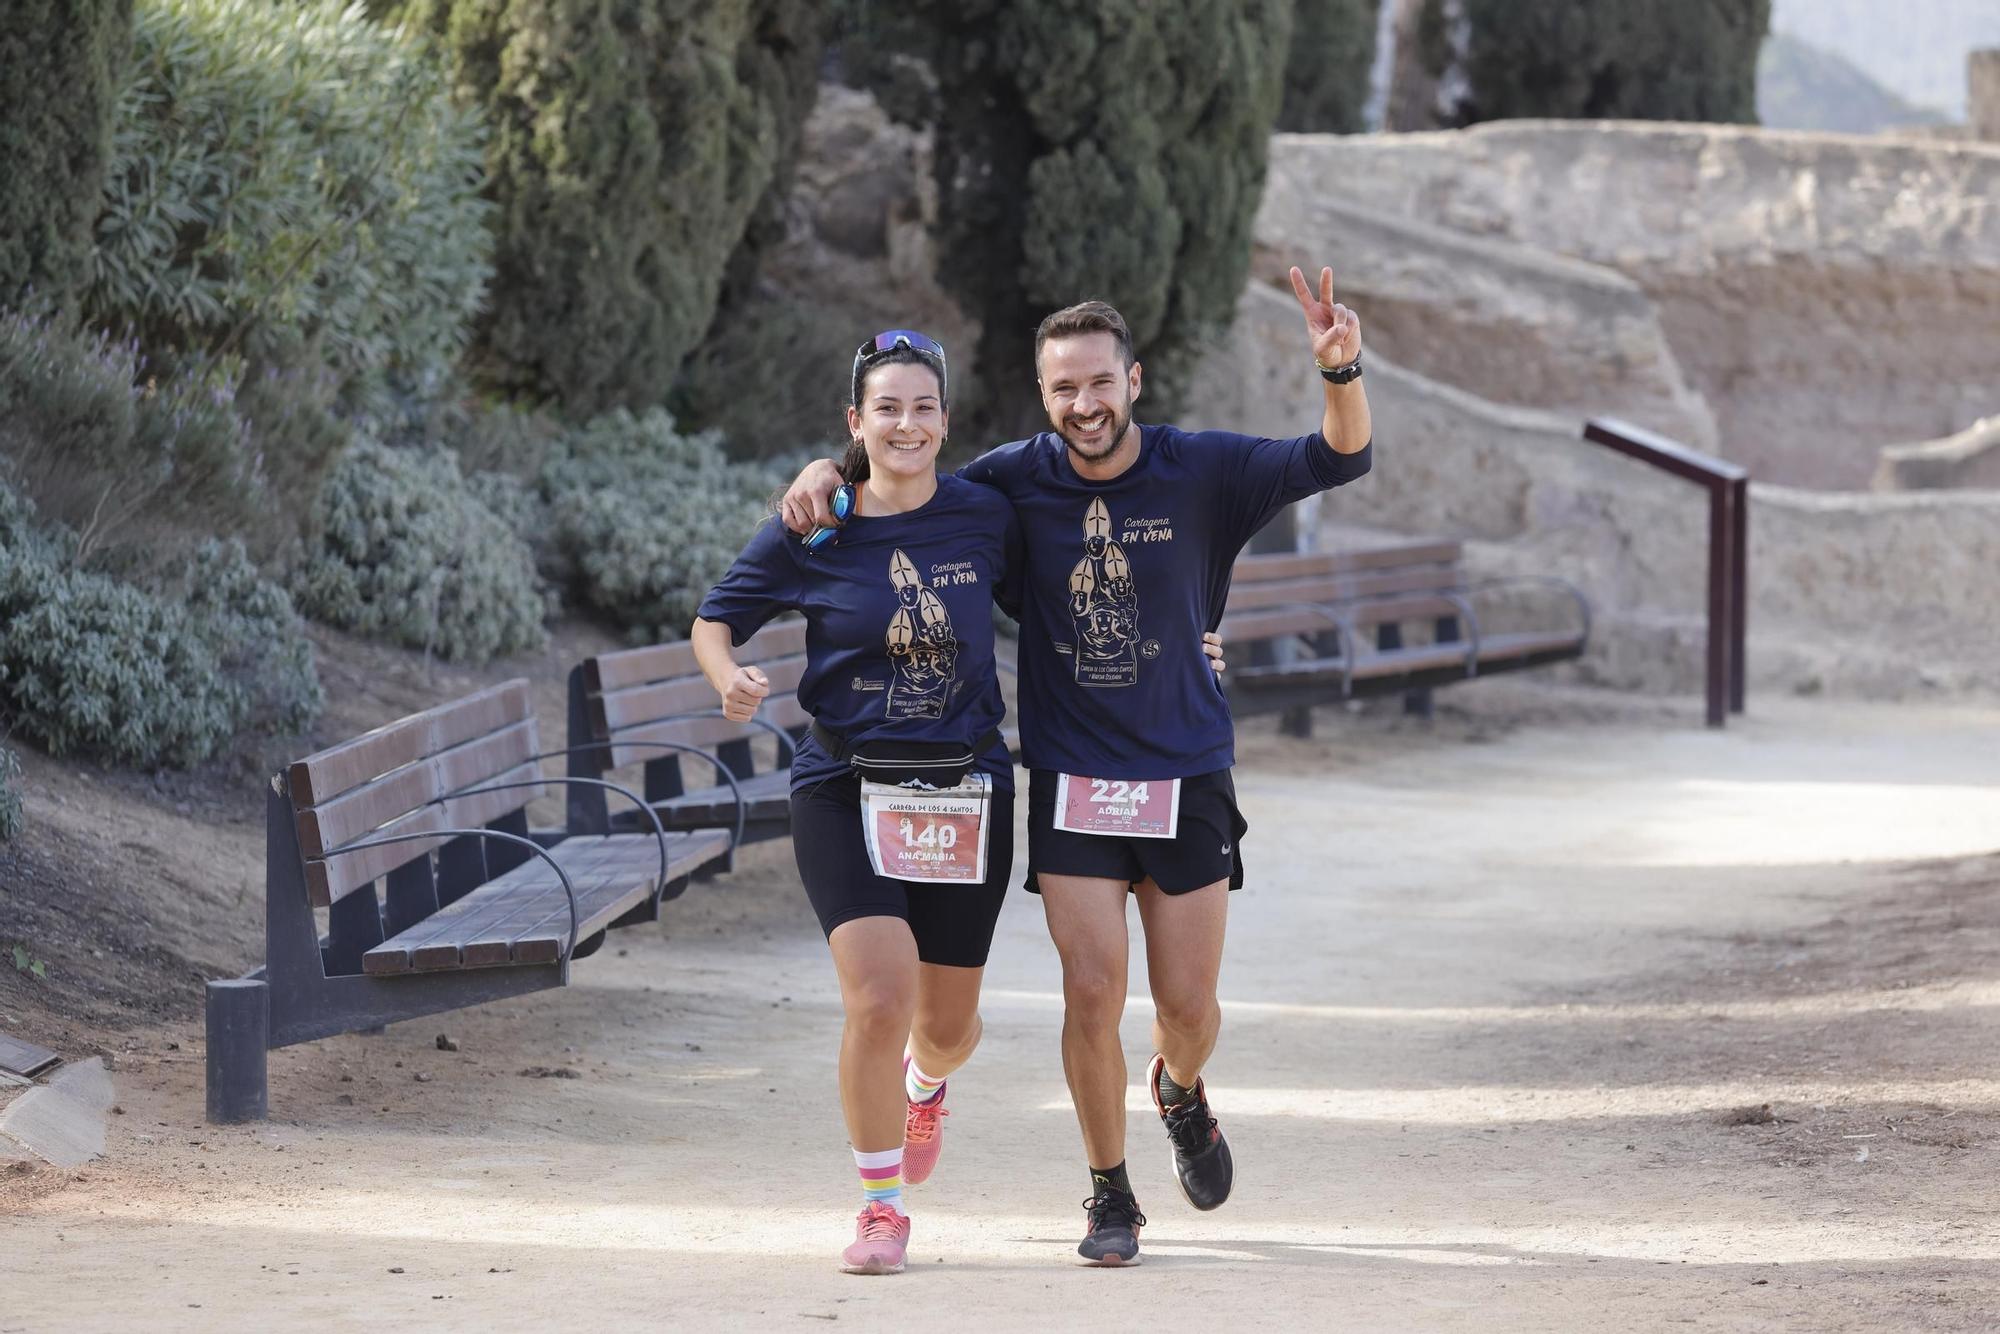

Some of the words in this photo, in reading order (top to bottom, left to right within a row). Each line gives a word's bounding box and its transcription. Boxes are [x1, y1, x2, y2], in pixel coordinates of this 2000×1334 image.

[1124, 517, 1170, 531] Cartagena
[1122, 530, 1140, 544] EN
[1143, 527, 1173, 543] VENA
[931, 561, 973, 574] Cartagena
[932, 574, 949, 588] EN
[952, 570, 978, 585] VENA
[1089, 779, 1150, 804] 224
[889, 803, 916, 811] CARRERA
[918, 804, 926, 812] DE
[949, 806, 974, 814] SANTOS
[1097, 807, 1139, 817] ADRIAN
[899, 822, 957, 849] 140
[898, 852, 920, 861] ANA
[923, 853, 956, 862] MARIA
